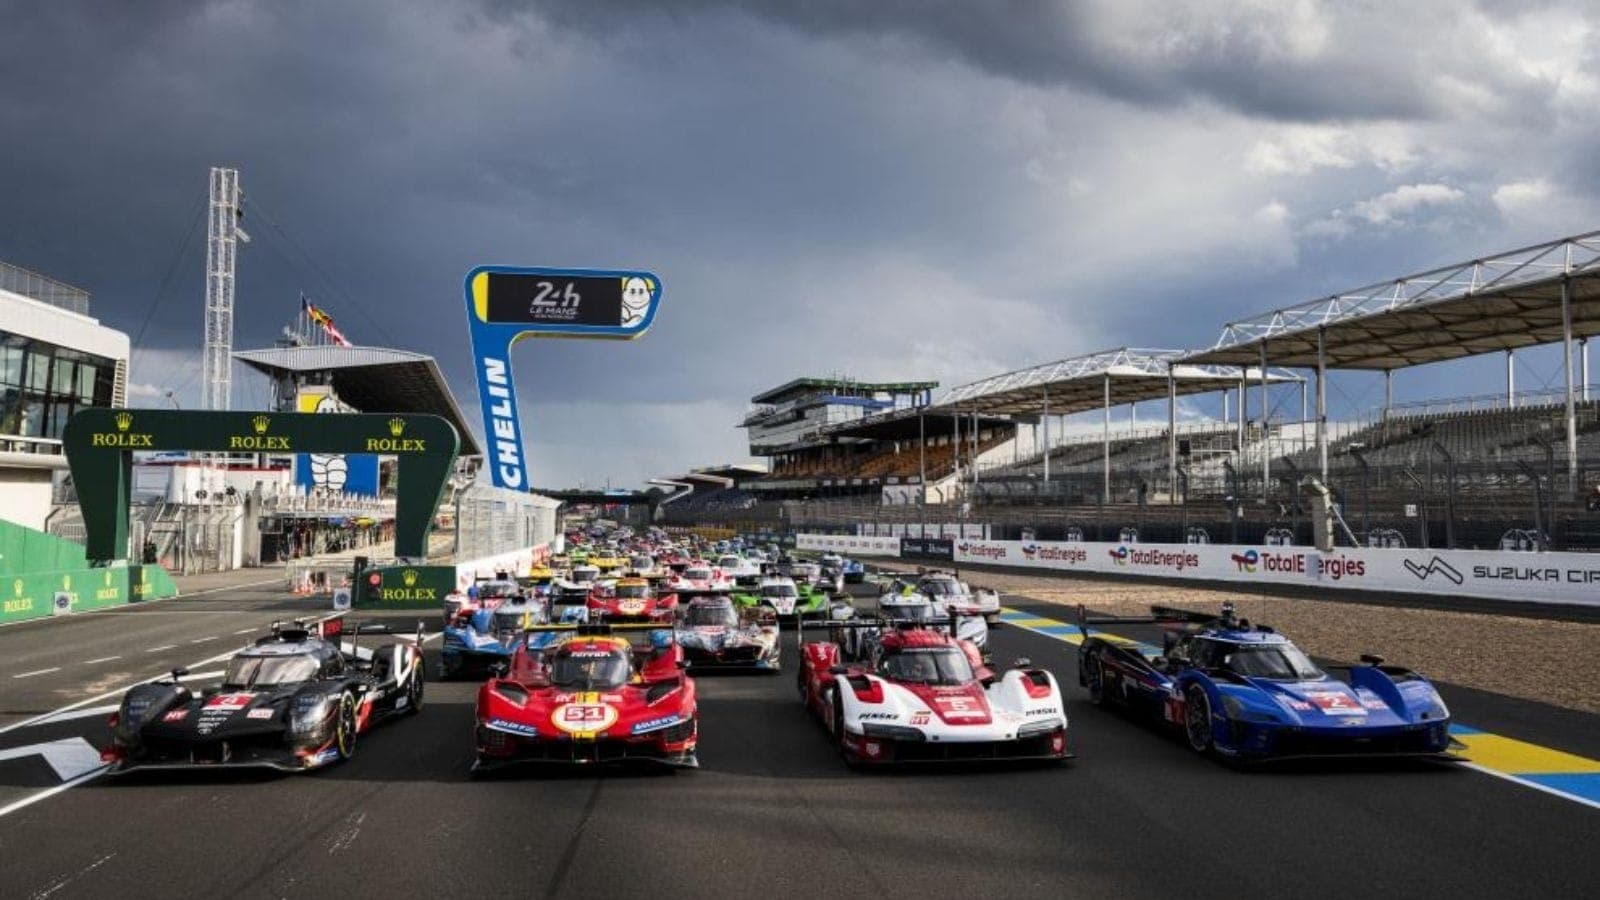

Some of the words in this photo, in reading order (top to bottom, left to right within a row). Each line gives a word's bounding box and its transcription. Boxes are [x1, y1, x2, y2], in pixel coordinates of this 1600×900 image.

[483, 357, 522, 489] CHELIN
[92, 433, 153, 447] ROLEX
[230, 436, 290, 449] ROLEX
[366, 438, 426, 452] ROLEX
[1037, 546, 1087, 563] TotalEnergies
[1129, 549, 1199, 570] TotalEnergies
[1260, 553, 1365, 580] TotalEergies
[1473, 565, 1560, 582] SUZUKA
[383, 588, 436, 600] ROLEX
[565, 706, 604, 720] 51
